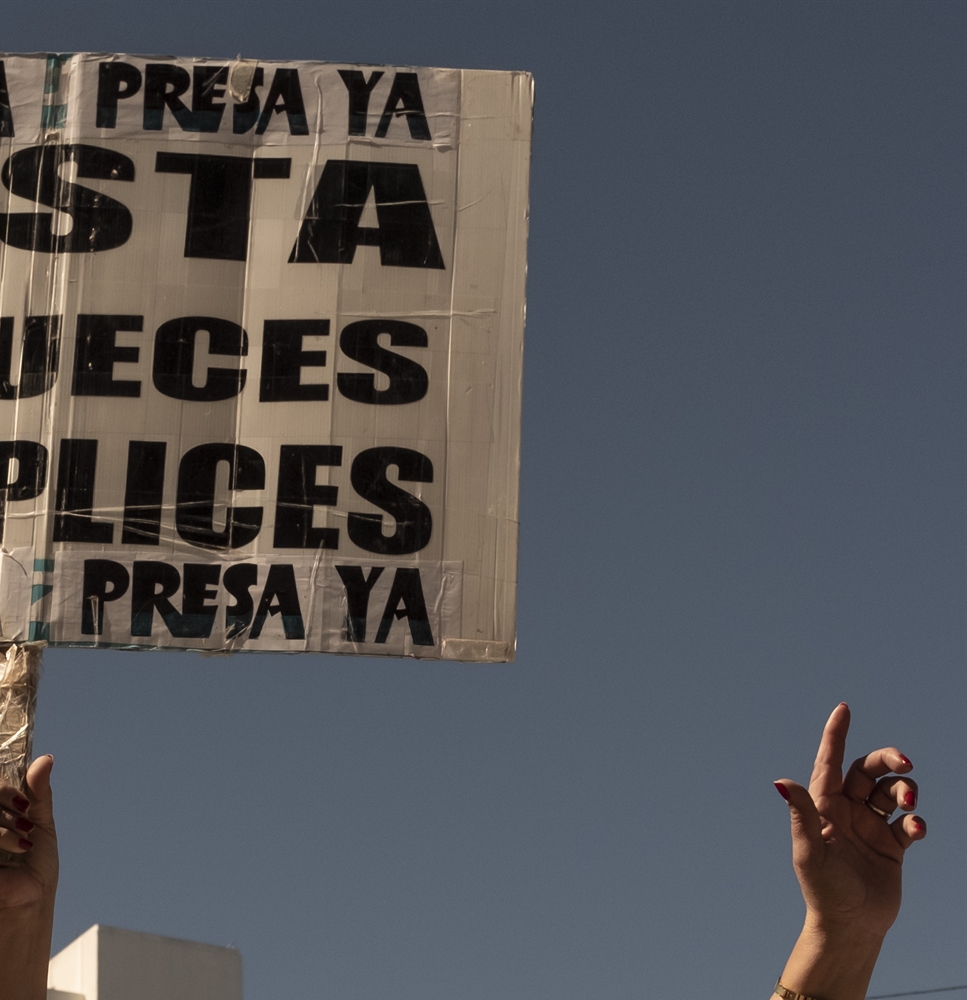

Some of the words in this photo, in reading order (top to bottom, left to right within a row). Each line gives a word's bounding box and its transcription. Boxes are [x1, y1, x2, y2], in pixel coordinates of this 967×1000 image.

[95, 61, 310, 136] PRESA
[337, 69, 432, 140] YA
[80, 558, 306, 641] PRESA
[334, 564, 435, 647] YA
